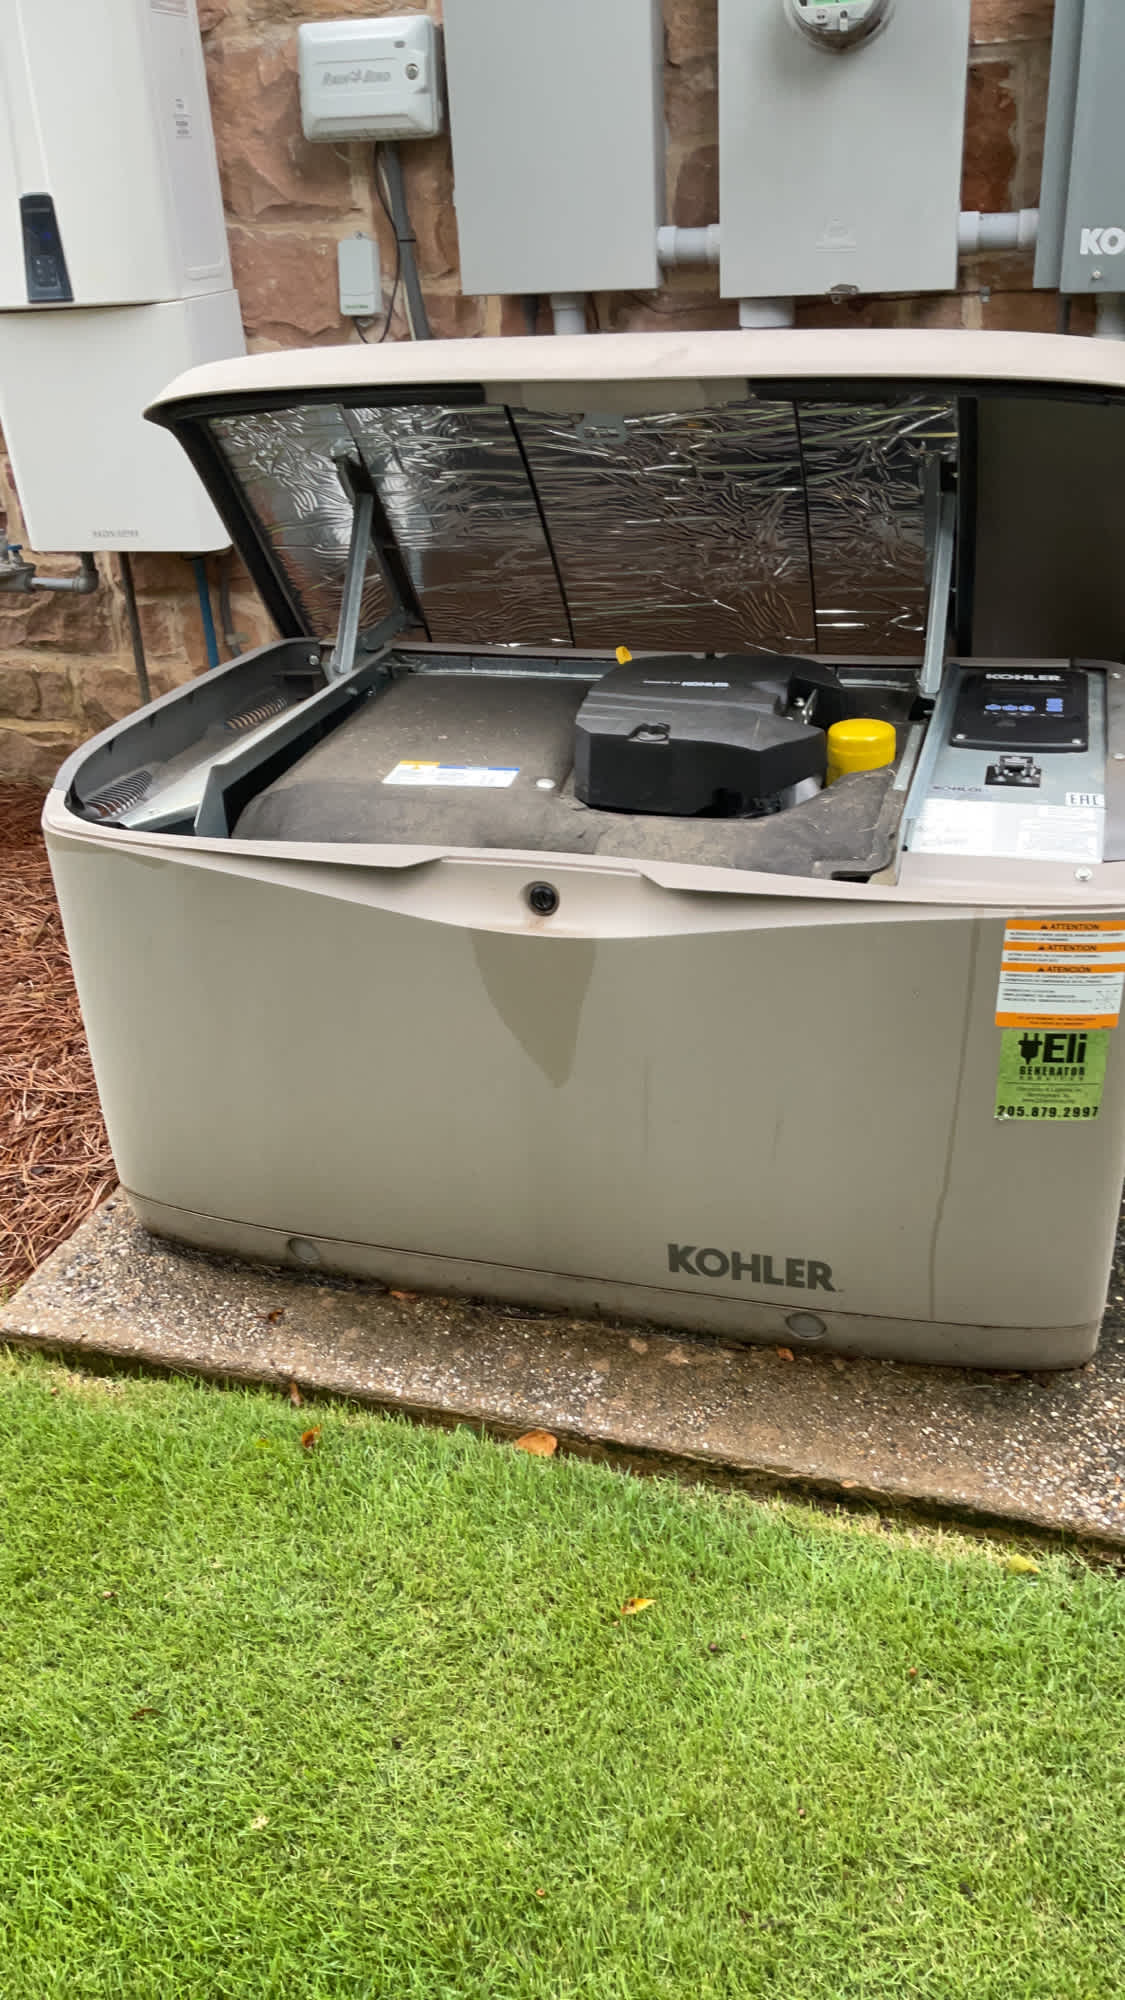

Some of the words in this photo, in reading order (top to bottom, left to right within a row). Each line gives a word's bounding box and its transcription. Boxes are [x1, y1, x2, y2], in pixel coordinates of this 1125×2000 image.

[1080, 228, 1125, 255] KO
[1042, 1033, 1087, 1063] Eli
[1019, 1066, 1085, 1076] GENERATOR
[998, 1105, 1098, 1118] 205.879.2997
[667, 1243, 837, 1292] KOHLER
